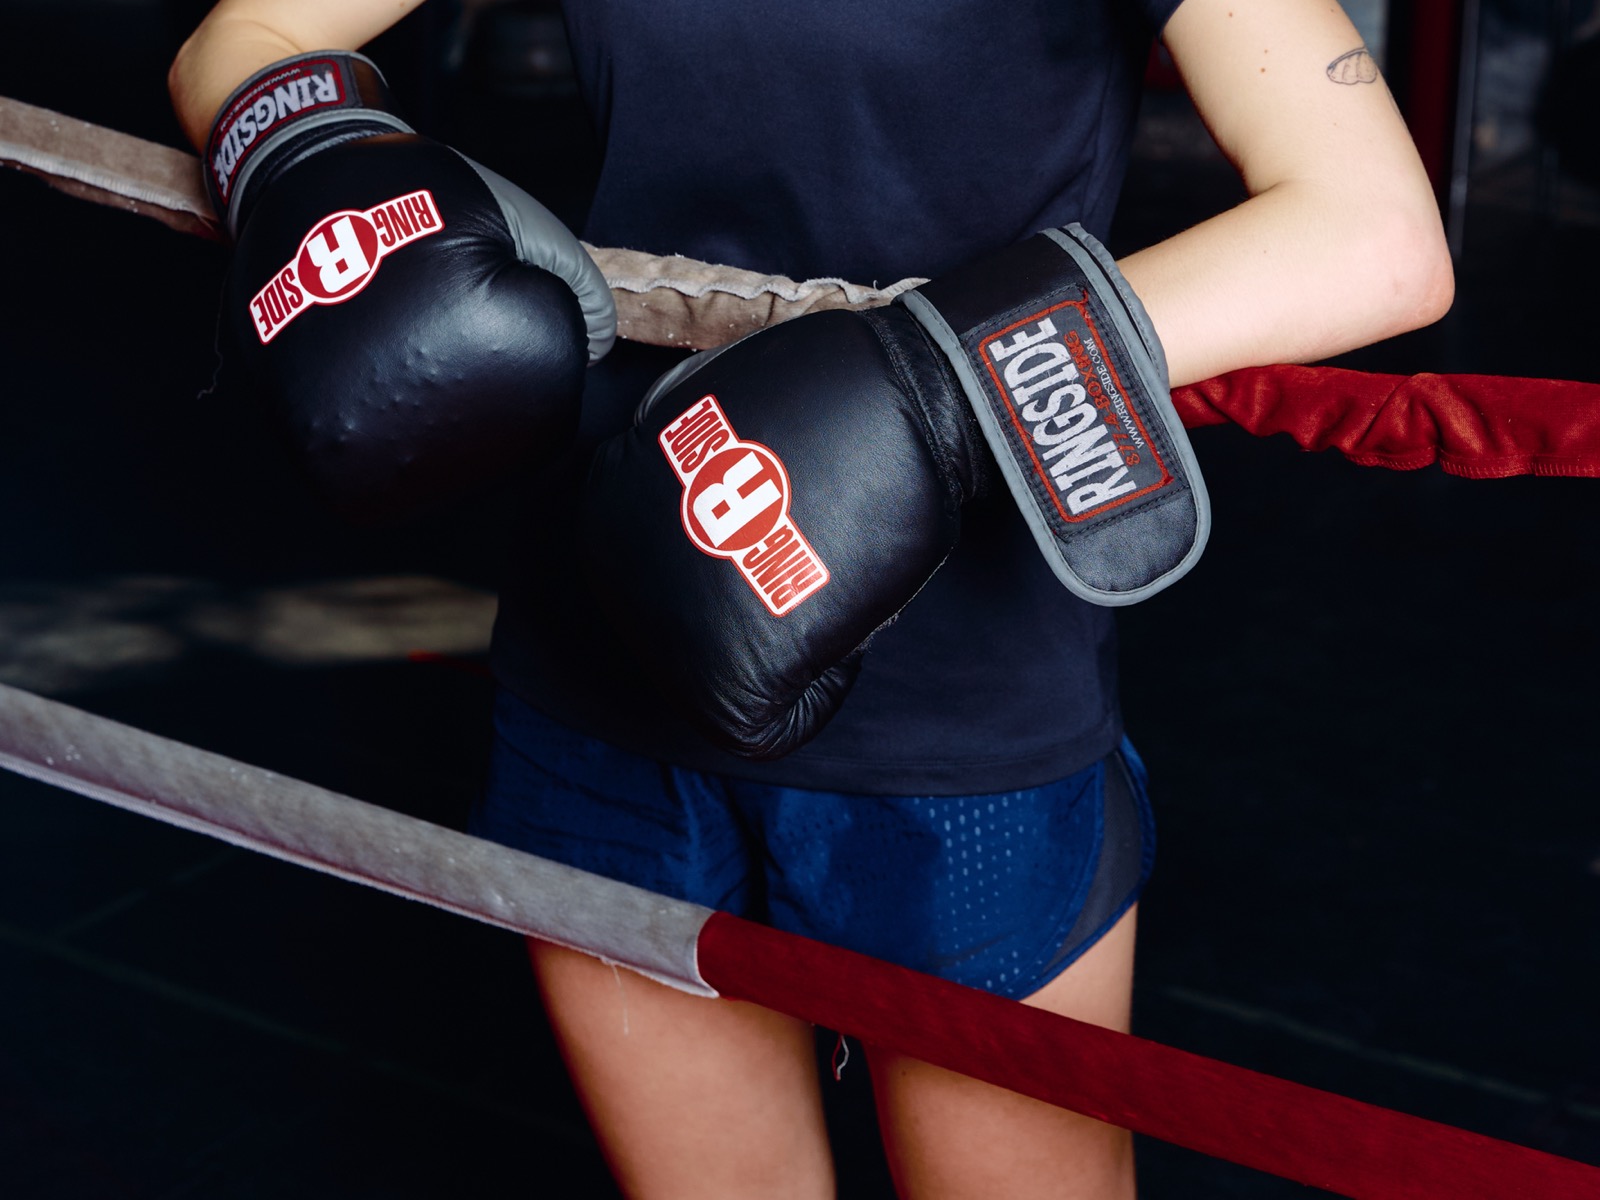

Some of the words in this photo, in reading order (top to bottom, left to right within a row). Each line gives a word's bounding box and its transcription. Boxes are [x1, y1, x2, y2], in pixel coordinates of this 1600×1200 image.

[214, 71, 338, 197] RINGSIDE
[306, 216, 370, 293] R
[371, 194, 437, 247] RING
[253, 268, 304, 337] SIDE
[989, 318, 1137, 515] RINGSIDE
[1083, 337, 1144, 449] WWW.RINGSIDE.COM
[665, 399, 729, 473] SIDE
[693, 451, 782, 548] R
[742, 524, 823, 609] RING
